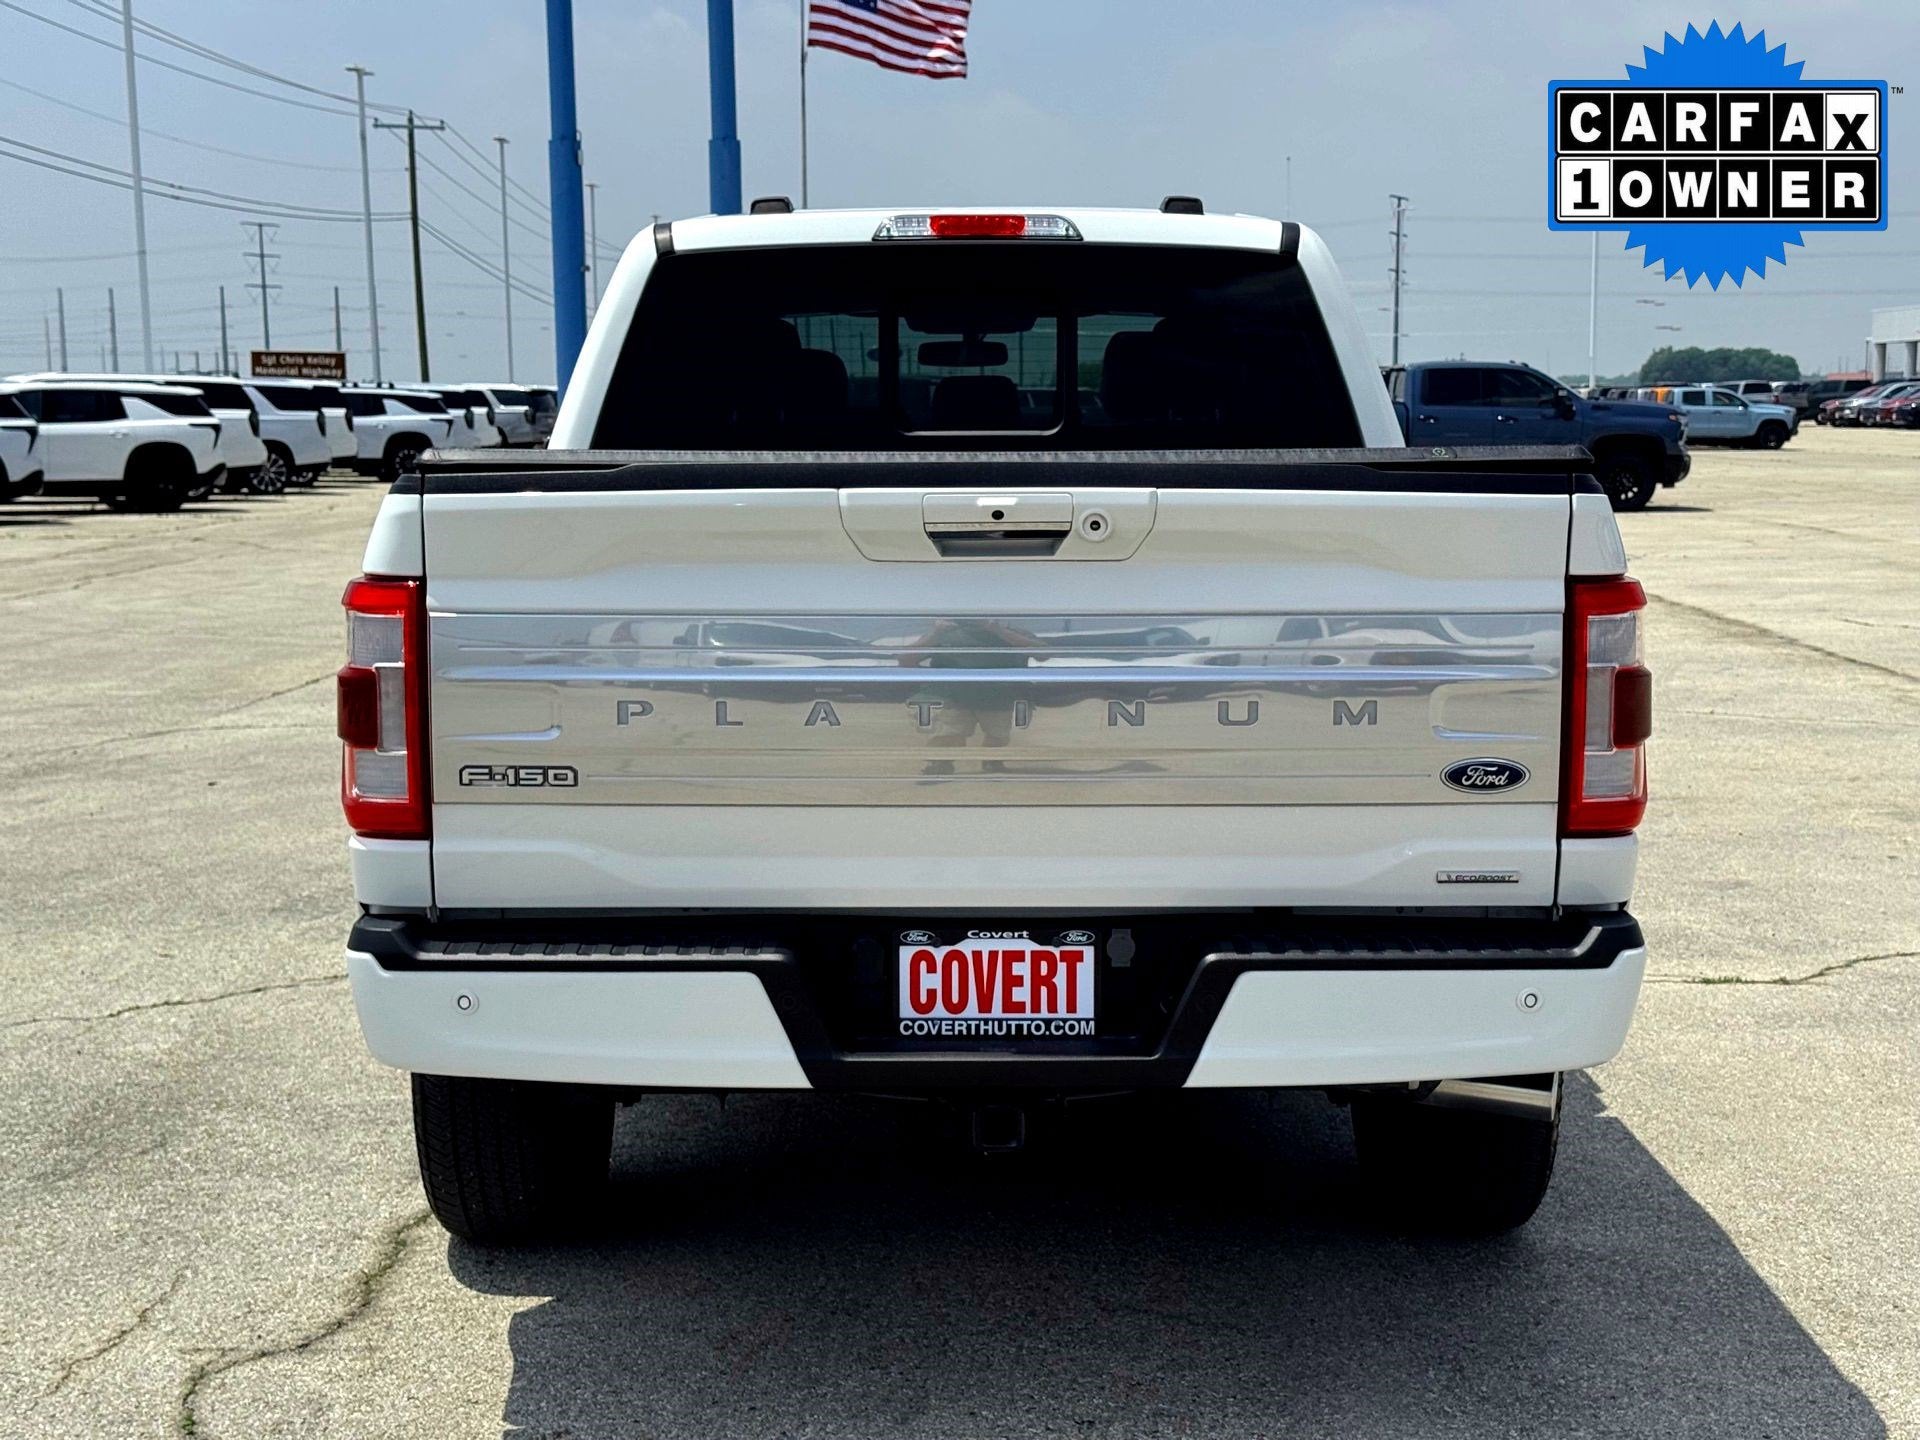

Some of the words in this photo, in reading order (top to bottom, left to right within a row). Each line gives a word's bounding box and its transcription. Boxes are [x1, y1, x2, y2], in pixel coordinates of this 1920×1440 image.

[261, 354, 277, 366] Sgt
[279, 355, 304, 365] Chris
[255, 366, 299, 376] Memorial
[301, 367, 343, 378] Highway
[616, 699, 1378, 727] PLATINUM
[459, 764, 579, 787] F-150
[1461, 765, 1510, 786] Ford
[906, 932, 929, 943] Ford
[967, 930, 1030, 939] Covert
[1066, 932, 1088, 943] Ford
[909, 949, 1084, 1015] COVERT
[900, 1020, 1095, 1036] COVERTHUTTO.COM
